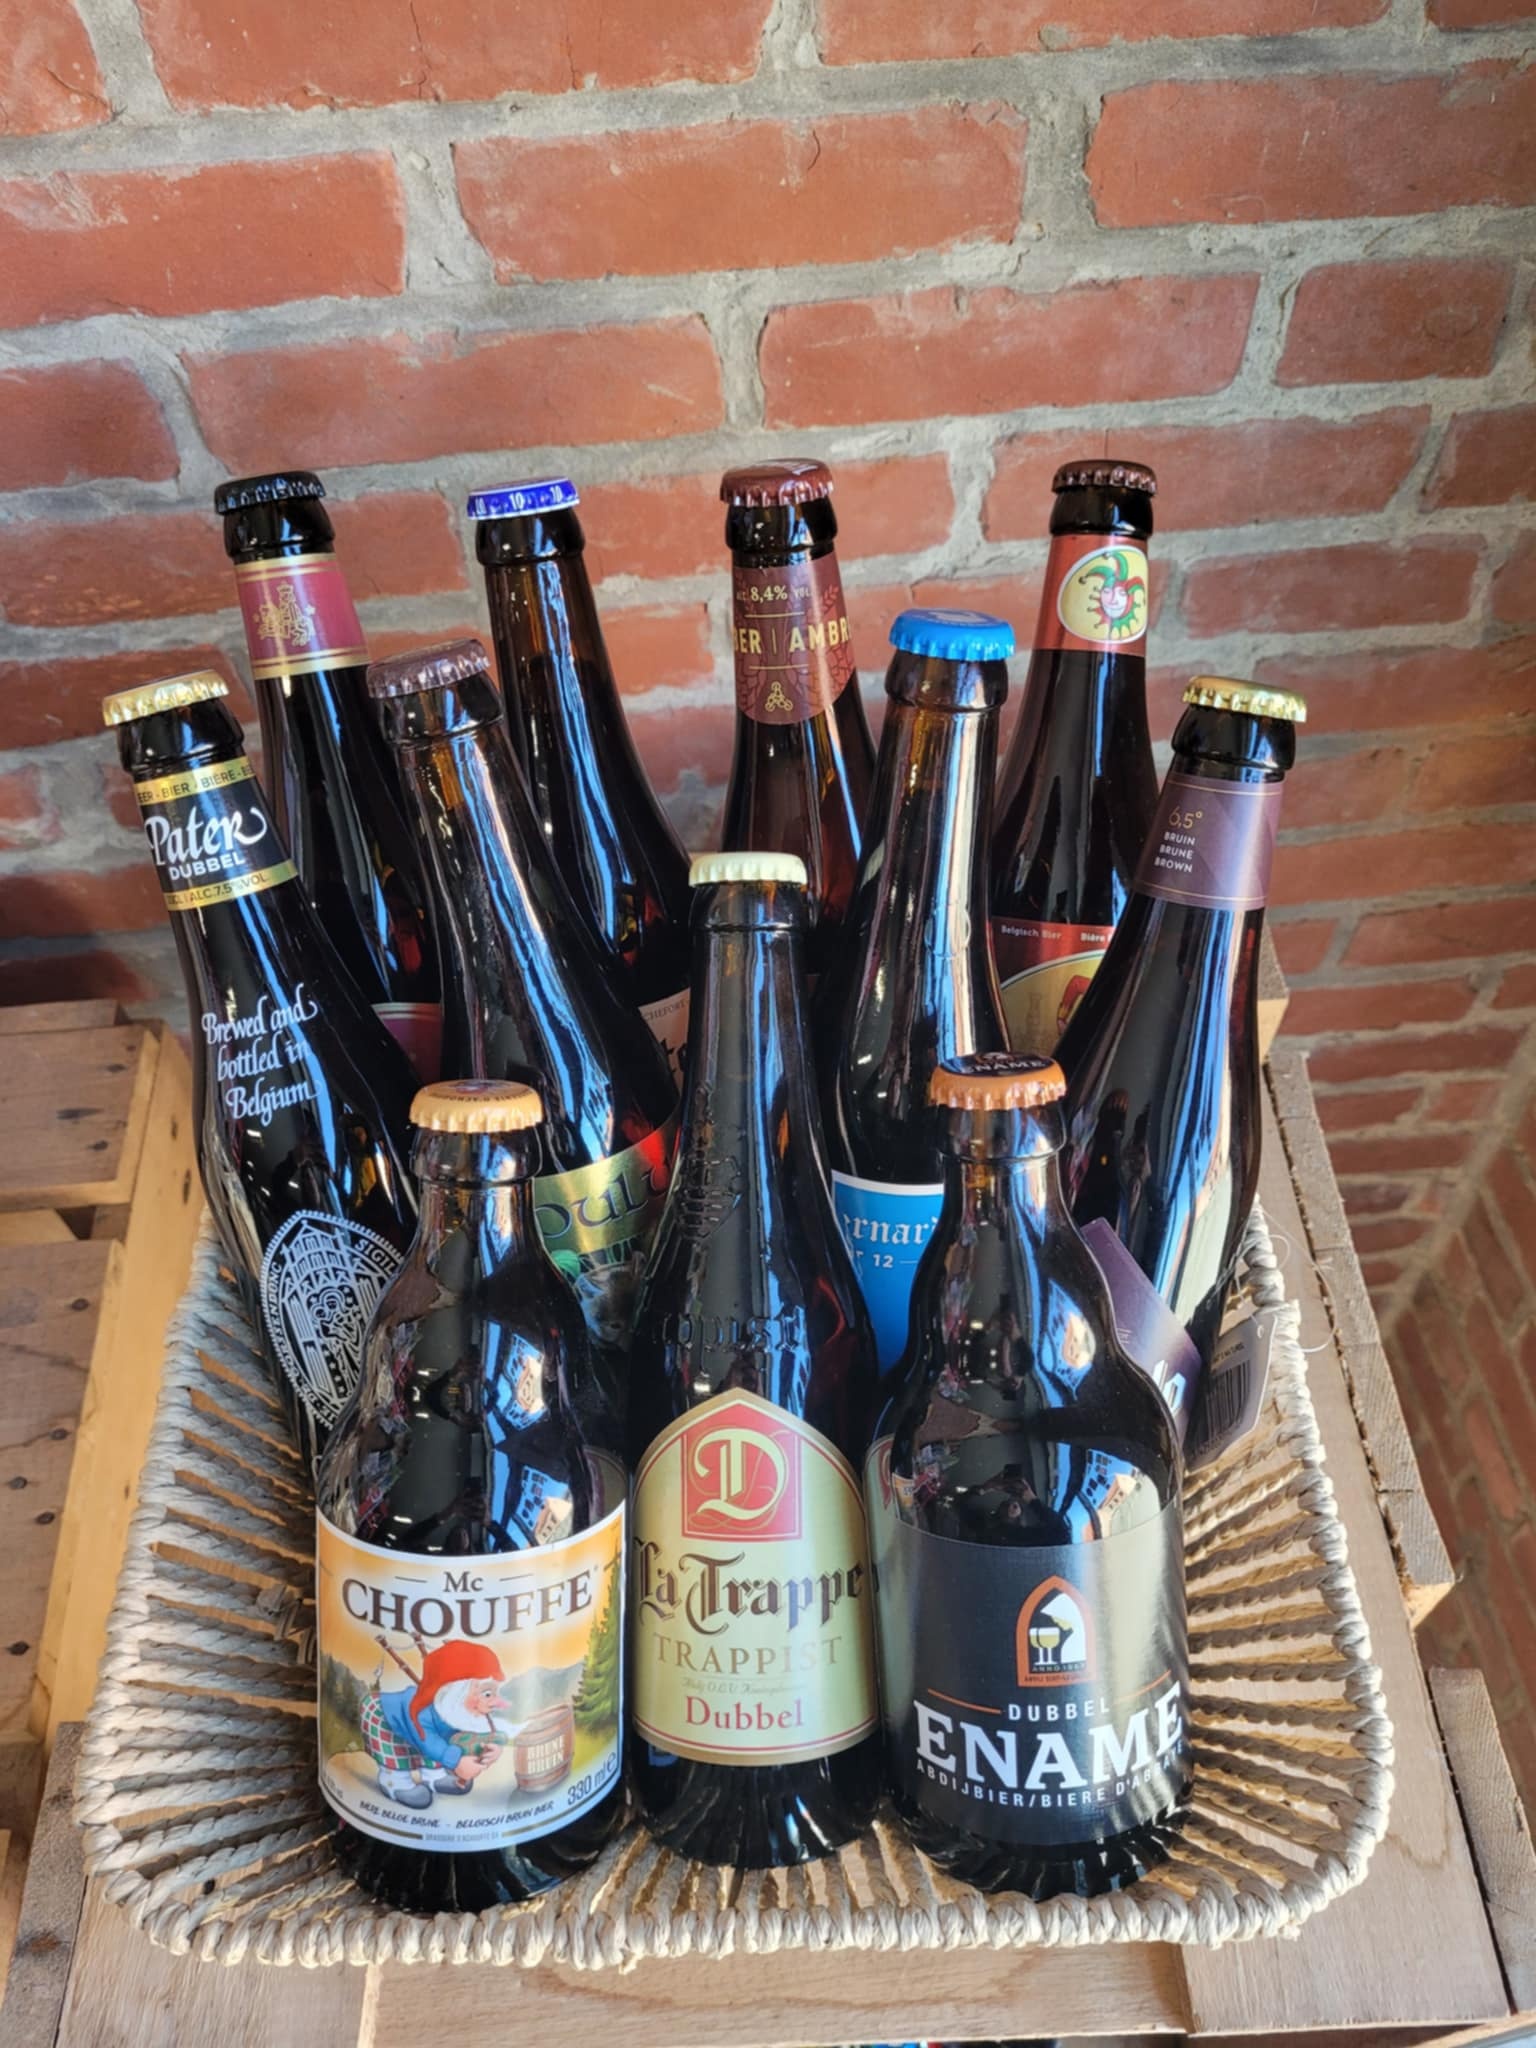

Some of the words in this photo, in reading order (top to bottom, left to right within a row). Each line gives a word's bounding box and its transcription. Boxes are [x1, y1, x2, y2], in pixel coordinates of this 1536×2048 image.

[509, 492, 525, 511] 10
[750, 585, 788, 603] 8,4%
[163, 783, 190, 799] BIER
[1160, 844, 1194, 860] BRUNE
[1164, 831, 1195, 846] BRUIN
[169, 851, 247, 881] DUBBEL
[1154, 857, 1193, 873] BROWN
[1001, 924, 1039, 938] Belgisch
[1041, 929, 1062, 940] Bier
[202, 995, 267, 1045] Brewed
[270, 982, 318, 1031] and
[217, 1030, 282, 1081] bottled
[285, 1039, 310, 1064] in
[226, 1077, 322, 1127] Belgium
[873, 1253, 894, 1269] 12
[443, 1571, 484, 1593] Mc
[678, 1551, 864, 1635] Trappe
[342, 1569, 593, 1638] CHOUFFE
[653, 1633, 843, 1676] TRAPPIST
[686, 1694, 805, 1731] Dubbel
[1008, 1697, 1110, 1722] DUBBEL
[913, 1680, 1184, 1791] ENAME
[567, 1774, 593, 1806] 330
[915, 1758, 1106, 1809] ABDIJBIER/BIERE
